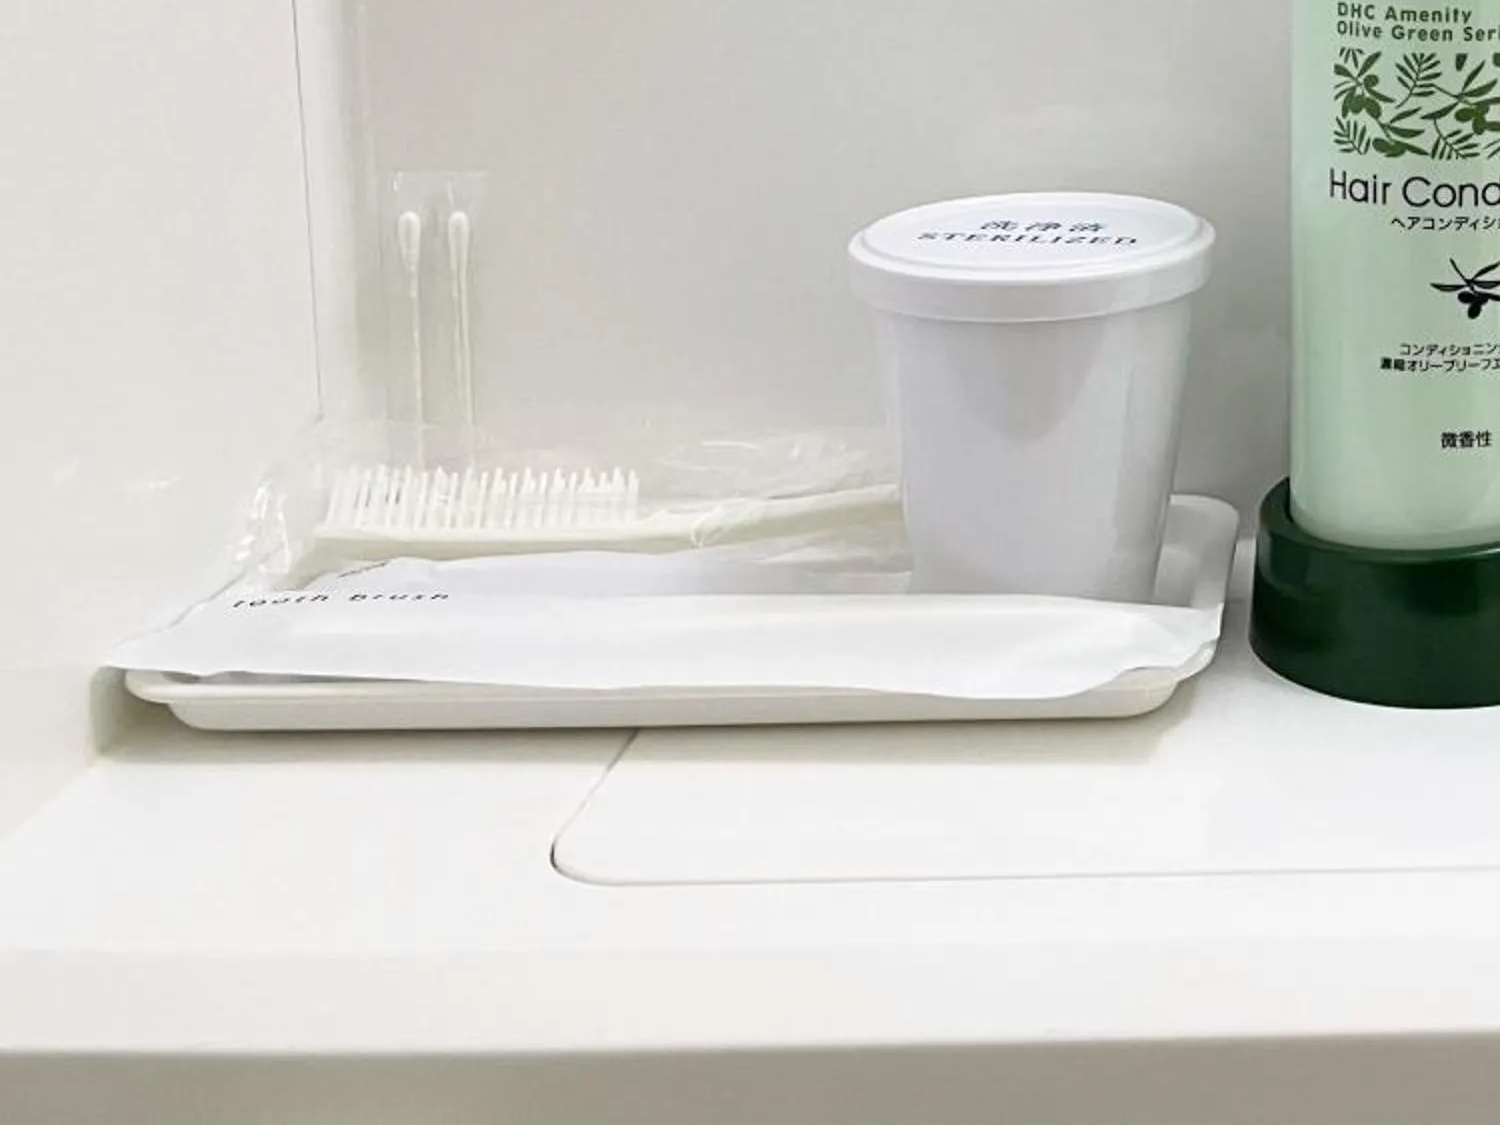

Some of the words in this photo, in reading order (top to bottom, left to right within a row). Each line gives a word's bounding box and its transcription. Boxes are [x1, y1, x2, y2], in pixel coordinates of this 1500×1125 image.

[1337, 2, 1375, 20] DHC
[1385, 6, 1472, 24] Amenity
[1337, 21, 1382, 39] Olive
[1391, 25, 1453, 41] Green
[1330, 168, 1391, 206] Hair
